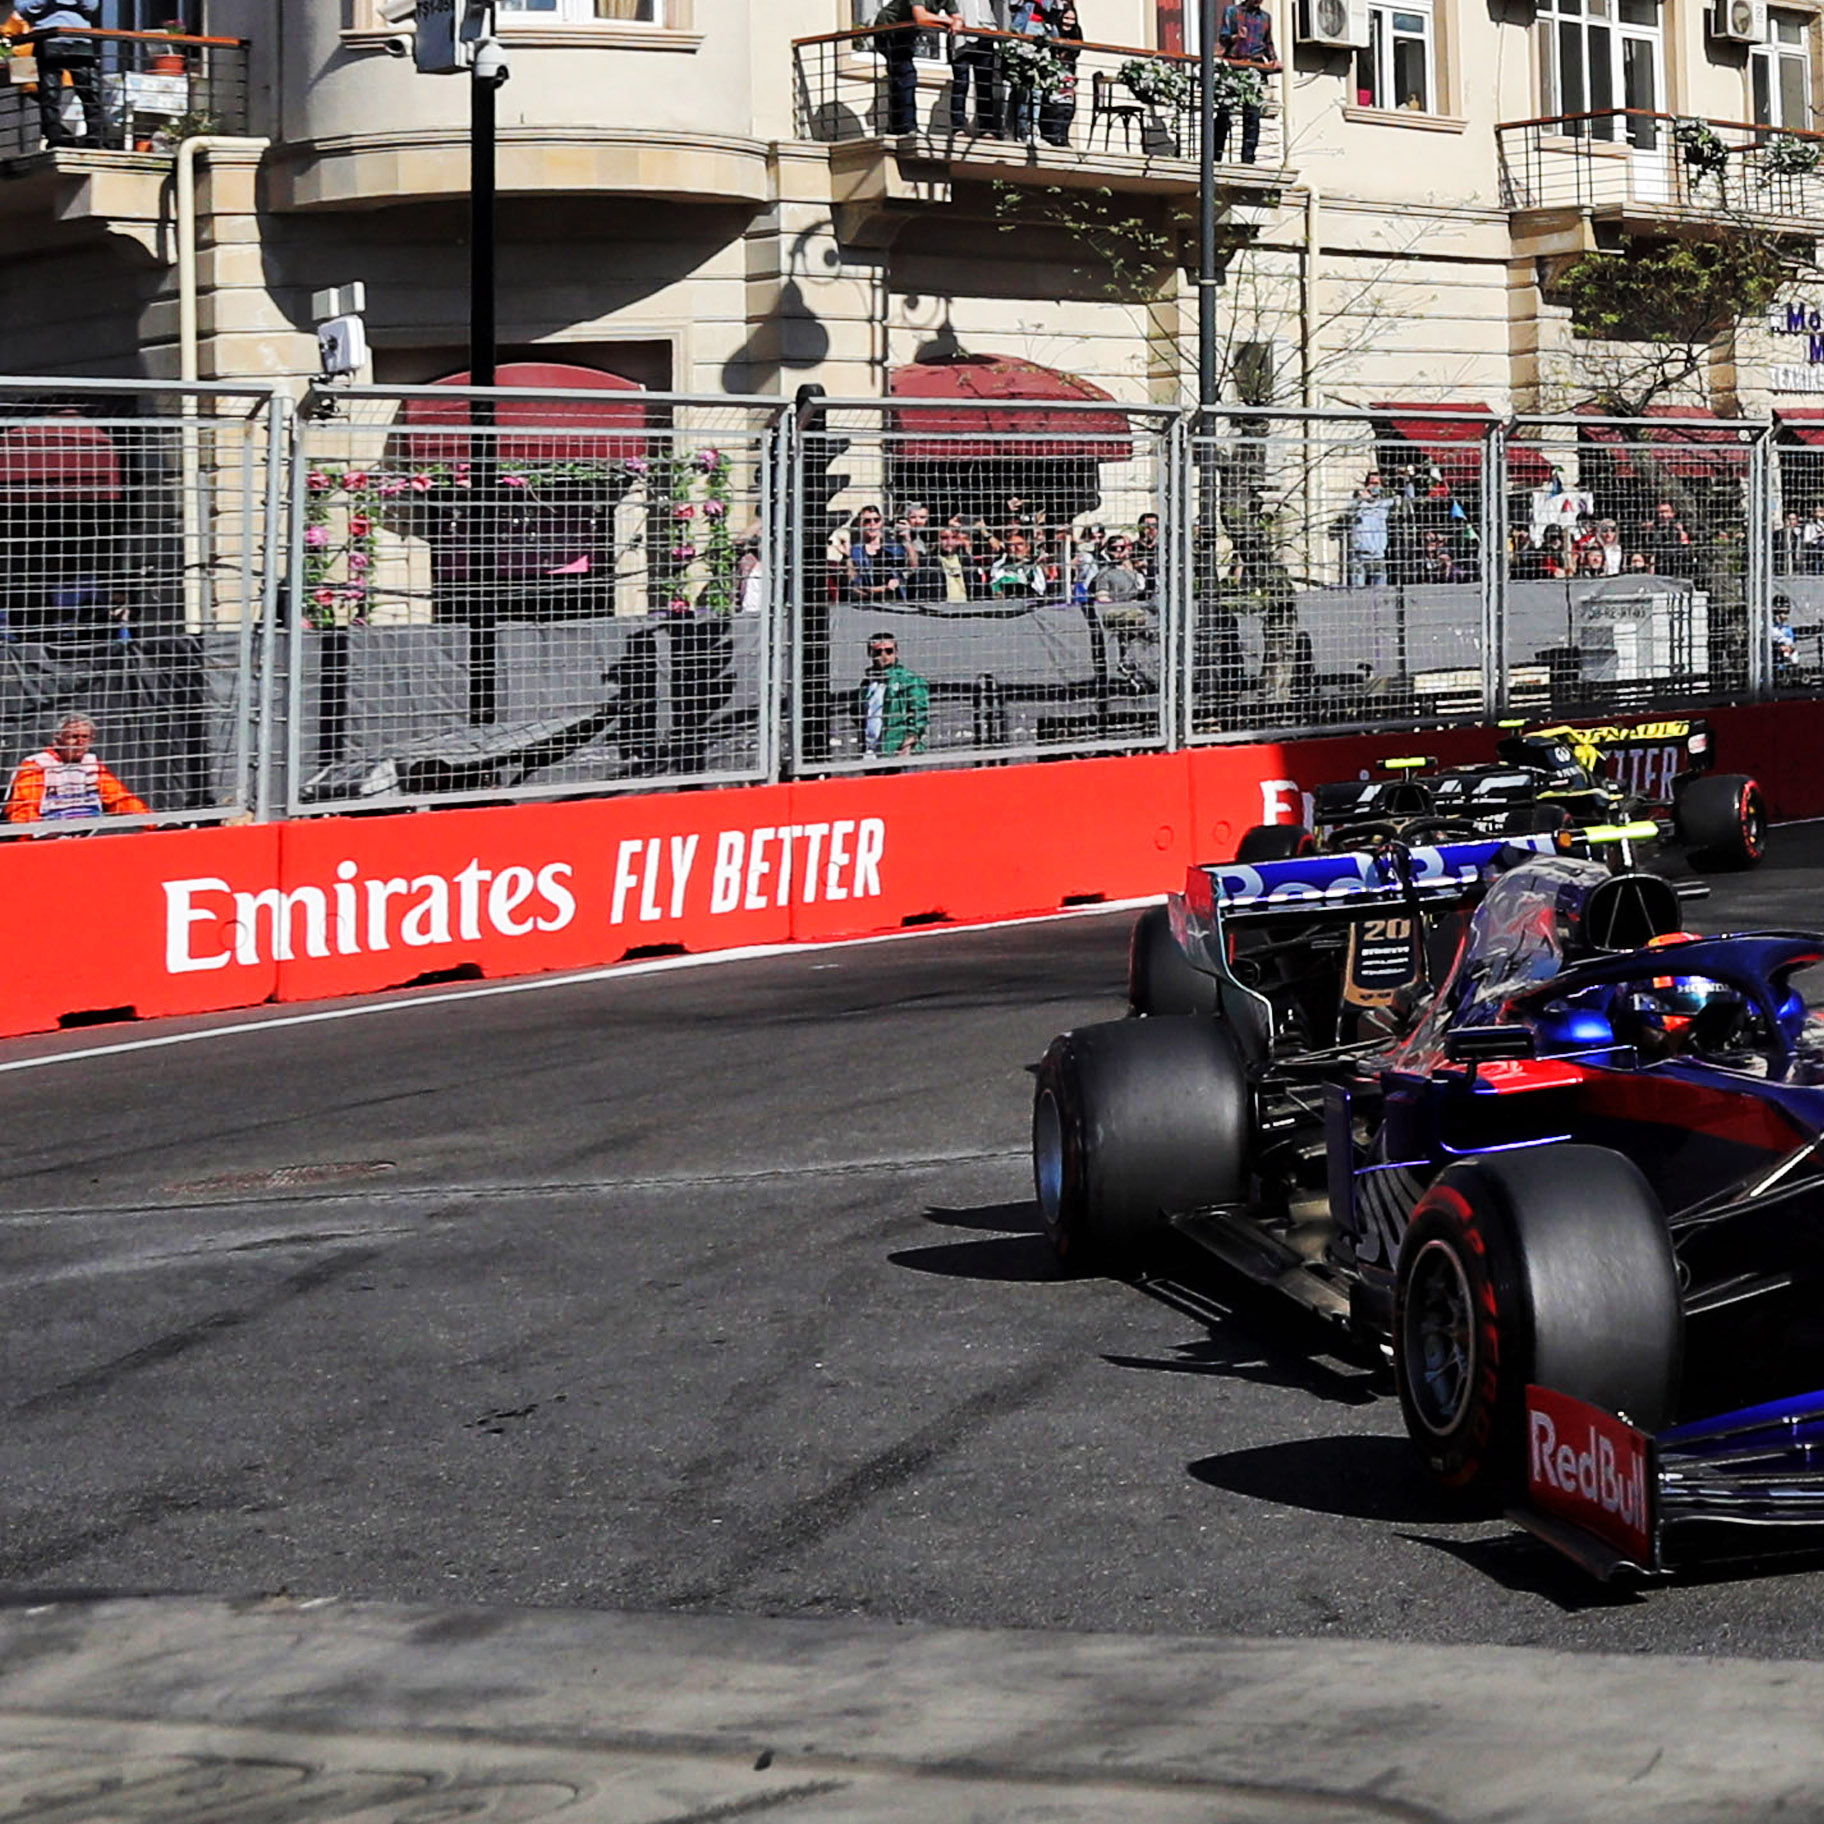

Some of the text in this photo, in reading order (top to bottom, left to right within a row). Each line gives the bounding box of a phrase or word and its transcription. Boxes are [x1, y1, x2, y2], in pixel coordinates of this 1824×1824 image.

[162, 818, 885, 974] Emirates FLY BETTER
[1363, 918, 1411, 941] 20
